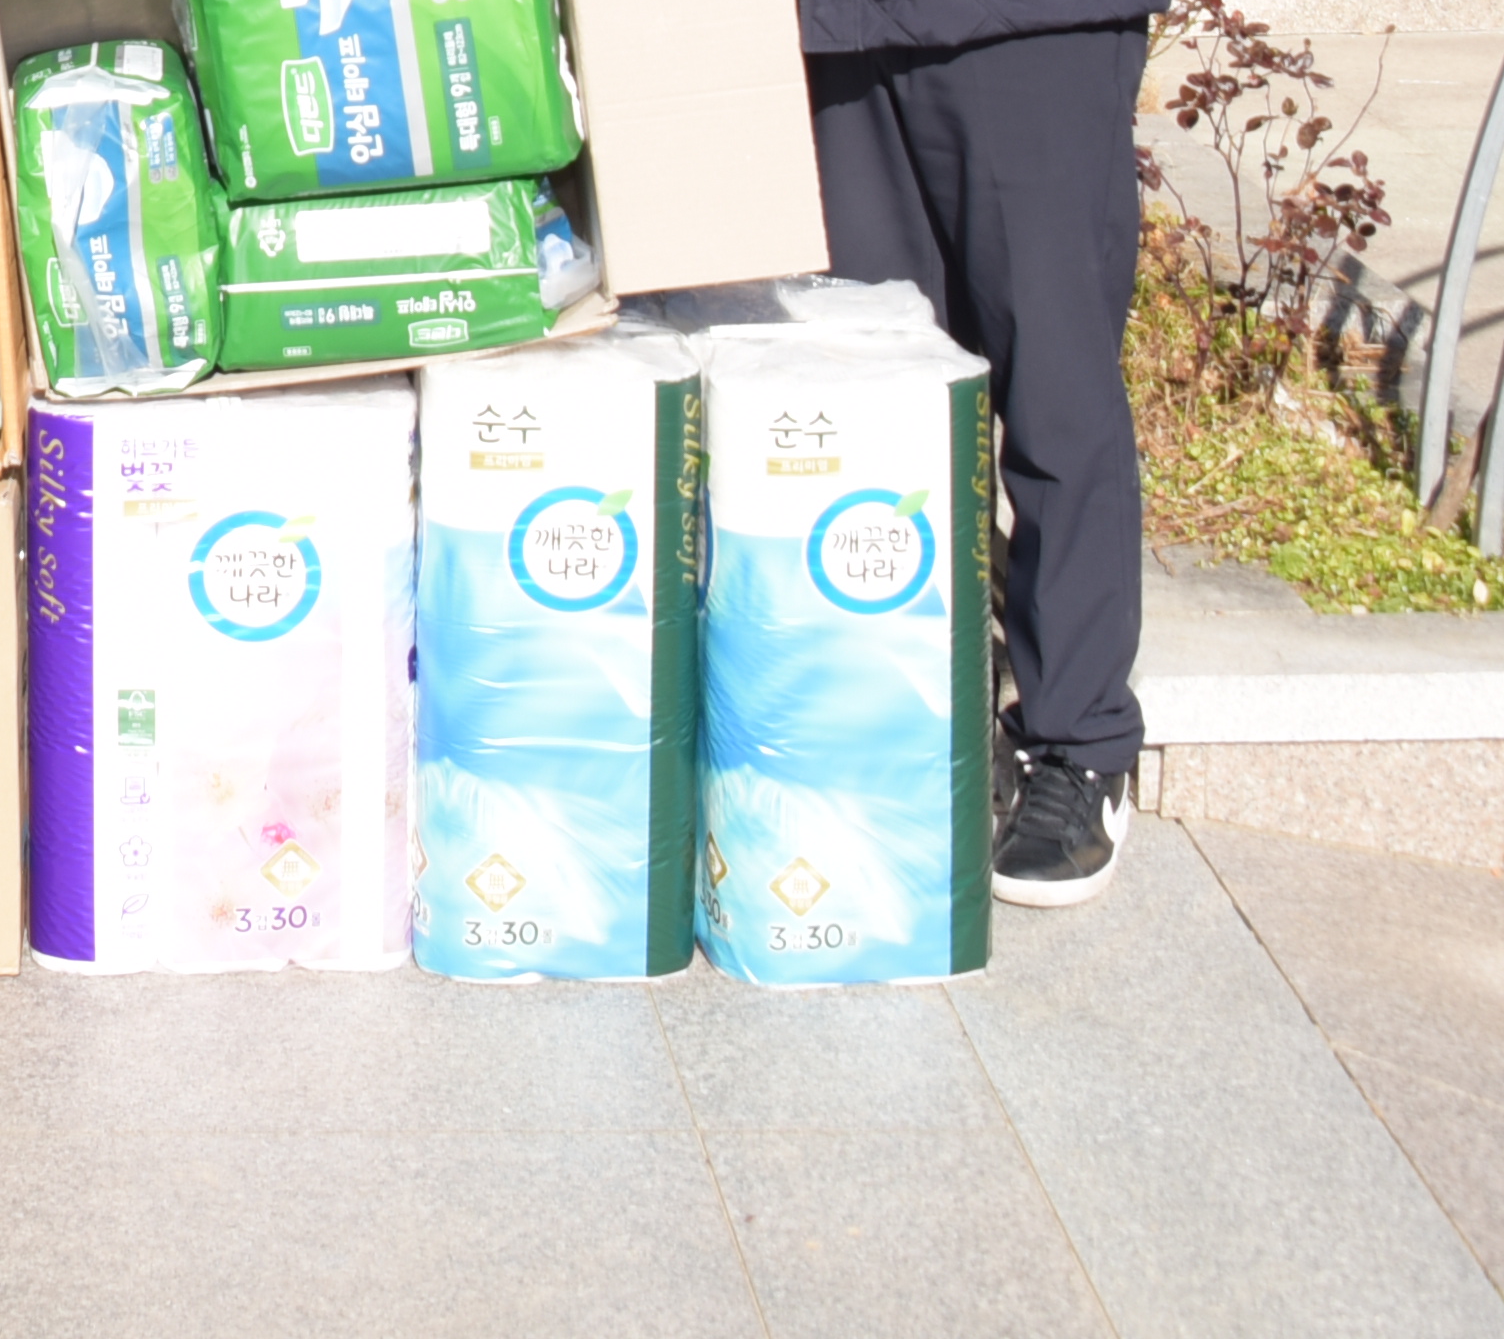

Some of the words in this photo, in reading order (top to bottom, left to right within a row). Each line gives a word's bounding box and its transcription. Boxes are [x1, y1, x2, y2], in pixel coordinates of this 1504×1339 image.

[339, 32, 369, 100] 테이프
[343, 102, 384, 163] 안심
[454, 99, 481, 150] 특대형
[90, 234, 115, 290] 테이프
[97, 293, 128, 338] 안심
[395, 296, 436, 313] 테이프
[438, 289, 475, 313] 안심
[472, 403, 543, 445] 순수
[768, 410, 839, 450] 순수
[677, 393, 700, 500] Silky
[37, 429, 70, 534] Silky
[533, 523, 615, 554] 깨끗한
[832, 525, 912, 555] 깨끗한
[35, 544, 68, 624] Soft
[214, 550, 298, 579] 깨끗한
[547, 555, 600, 581] 나라
[846, 557, 898, 584] 나라
[229, 584, 283, 609] 나라
